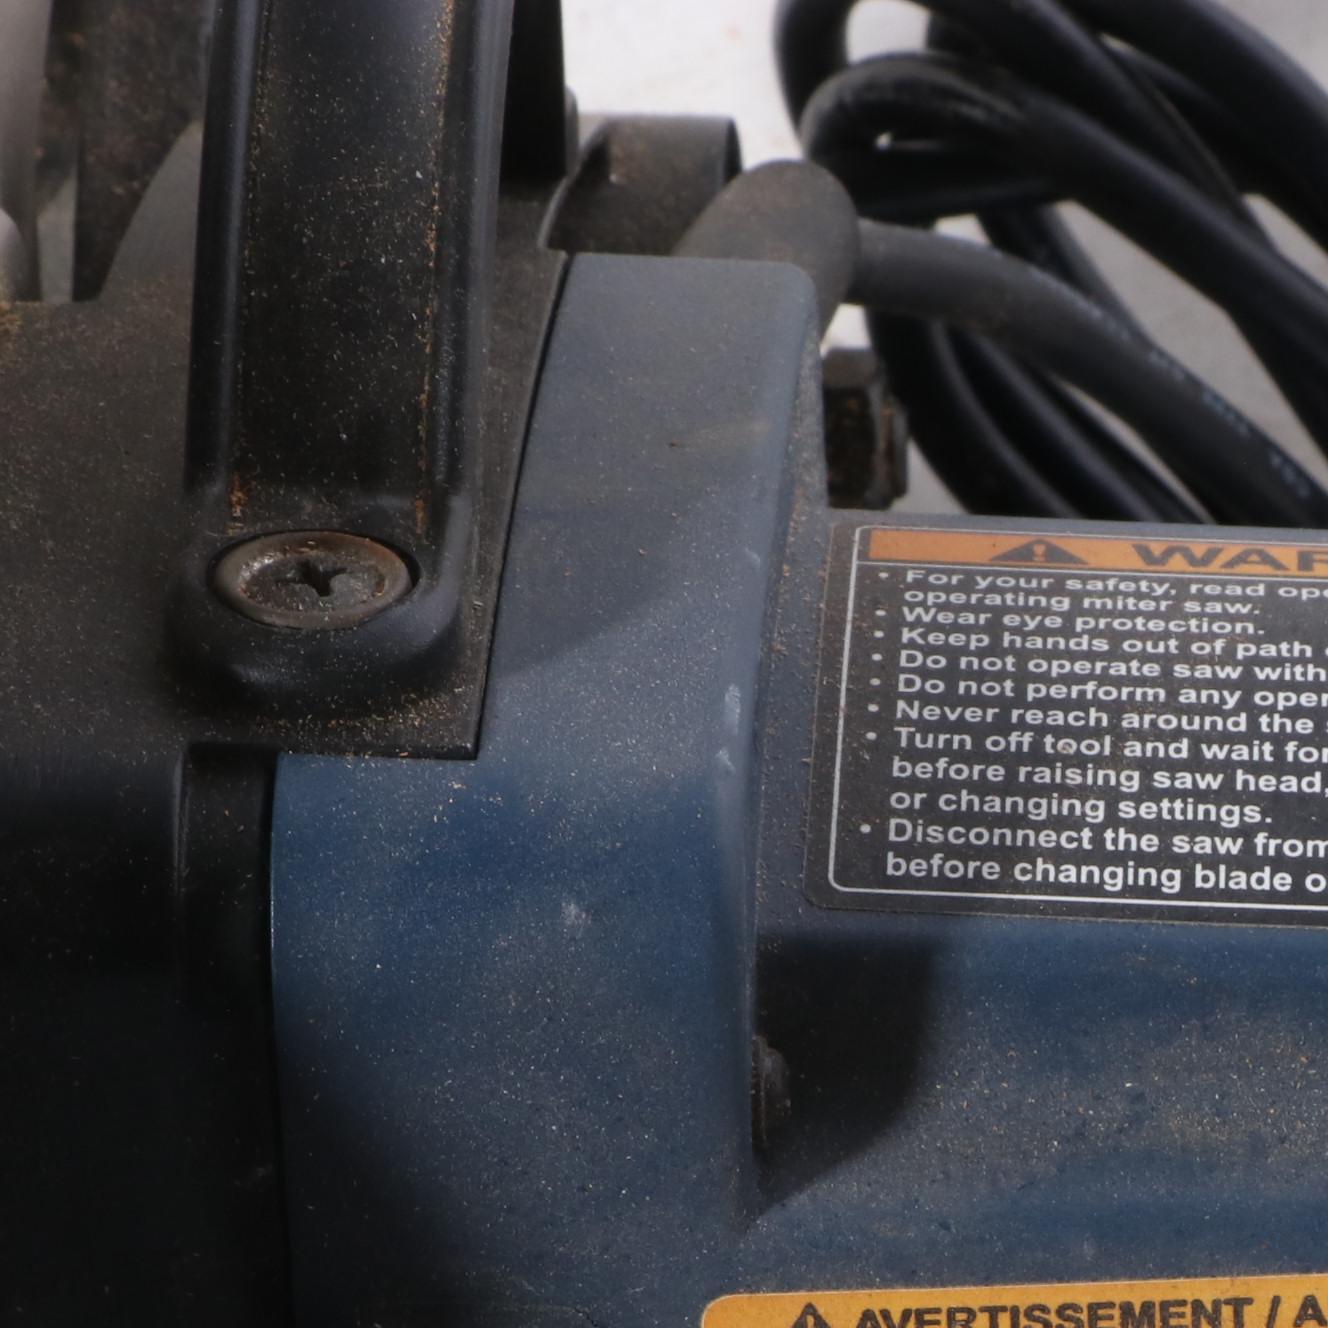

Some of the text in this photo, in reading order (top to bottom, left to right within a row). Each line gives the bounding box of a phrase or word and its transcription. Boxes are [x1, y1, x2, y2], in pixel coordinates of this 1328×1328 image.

[905, 569, 963, 585] For
[974, 575, 1053, 591] your
[1065, 575, 1176, 596] safety,
[1189, 579, 1265, 596] read
[903, 588, 1259, 615] operating miter saw.
[902, 606, 1264, 639] Wear eye protection.
[900, 627, 989, 650] Keep
[1002, 630, 1109, 650] hands
[1121, 635, 1178, 652] out
[1190, 635, 1225, 653] of
[1236, 637, 1312, 659] path
[899, 649, 947, 669] Do
[959, 652, 1016, 671] not
[1026, 654, 1161, 679] operate
[1173, 662, 1242, 678] saw
[897, 673, 945, 694] Do
[957, 676, 1015, 696] not
[1026, 677, 1165, 705] perform
[1178, 687, 1241, 708] any
[895, 699, 1000, 723] Never
[1011, 703, 1108, 726] reach
[1121, 706, 1247, 731] around
[1258, 711, 1314, 733] the
[892, 727, 972, 750] Turn
[984, 729, 1032, 752] off
[1042, 731, 1111, 755] tool
[1123, 734, 1188, 758] and
[1200, 737, 1274, 761] wait
[891, 756, 1005, 781] before
[1017, 760, 1139, 791] raising
[1152, 770, 1224, 789] saw
[889, 788, 1272, 830] or changing settings.
[887, 818, 1093, 850] Disconnect
[1102, 826, 1159, 852] the
[1171, 834, 1243, 855] saw
[885, 851, 1001, 880] before
[1013, 856, 1181, 893] changing
[1194, 863, 1292, 891] blade
